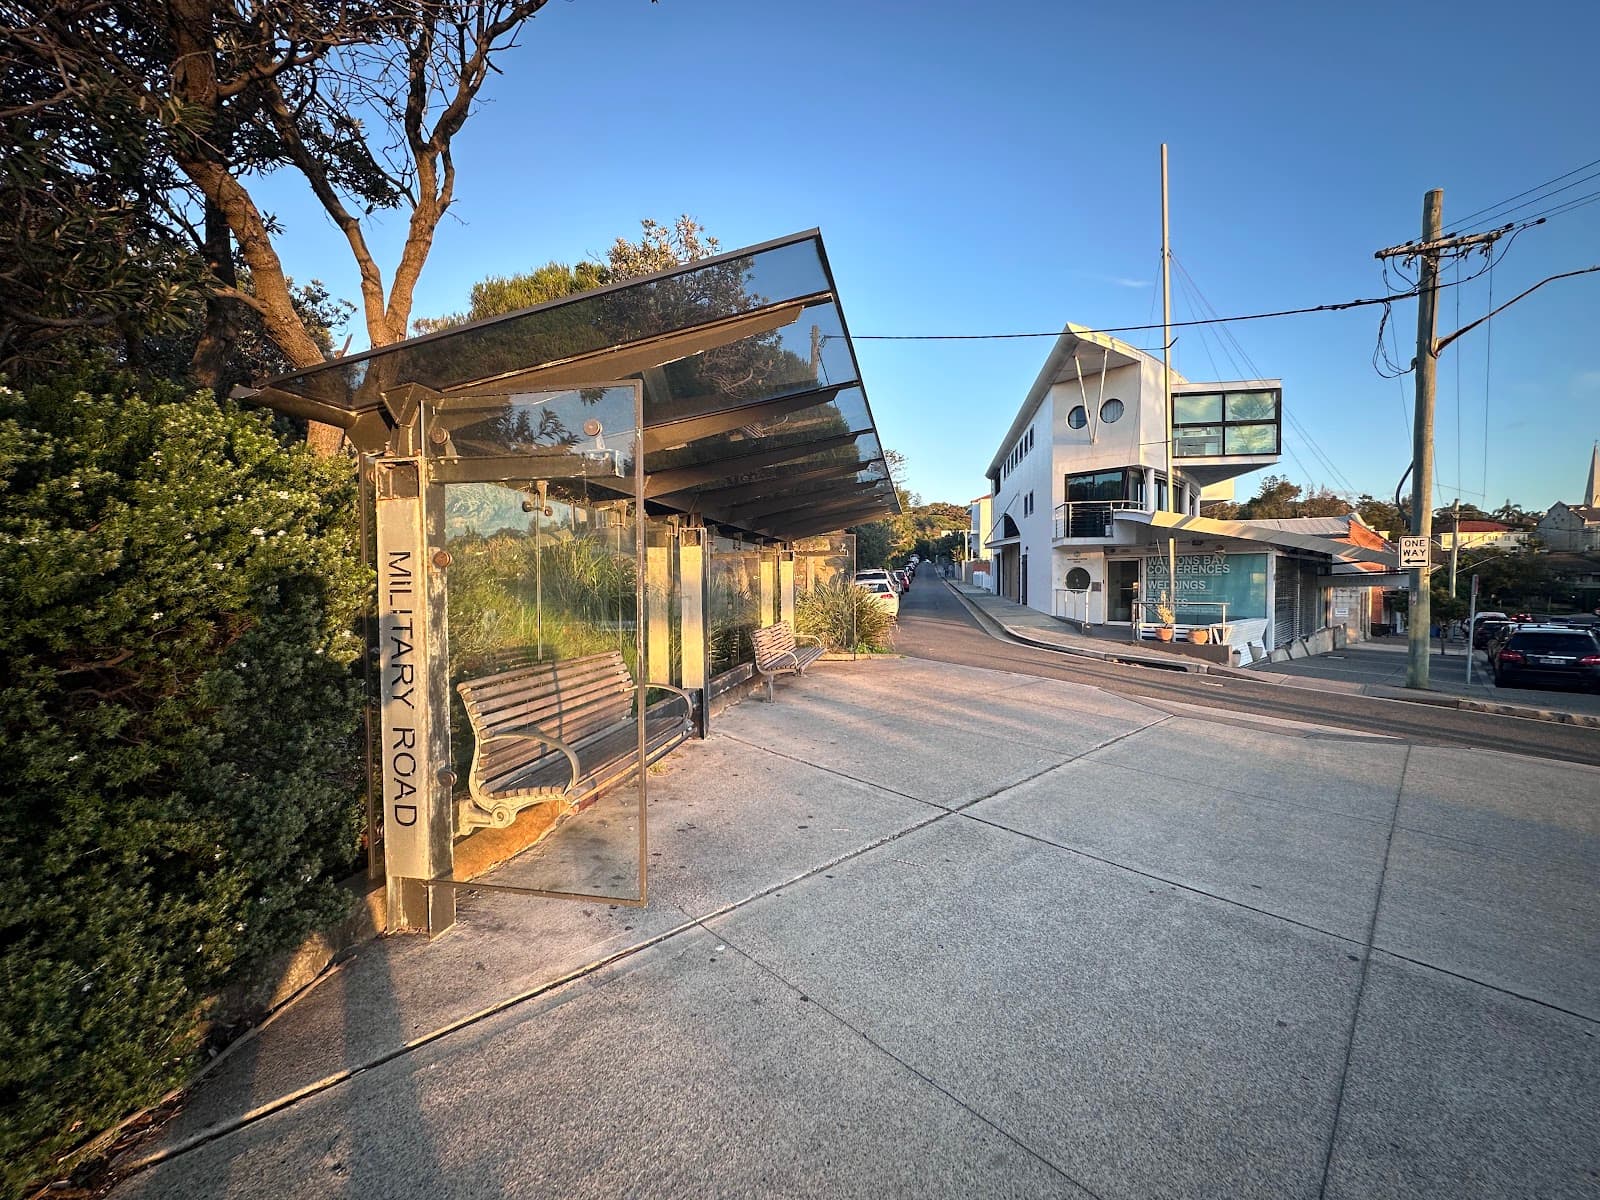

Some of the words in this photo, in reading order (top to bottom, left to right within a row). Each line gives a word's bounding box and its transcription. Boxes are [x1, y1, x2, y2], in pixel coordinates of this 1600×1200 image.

[1403, 549, 1426, 557] WAY
[1148, 556, 1200, 566] WATONS
[1203, 555, 1226, 565] BAY
[1147, 564, 1231, 574] CONERENCES
[1147, 598, 1188, 608] EVTS
[388, 551, 415, 710] MILITARY
[392, 727, 418, 827] ROAD
